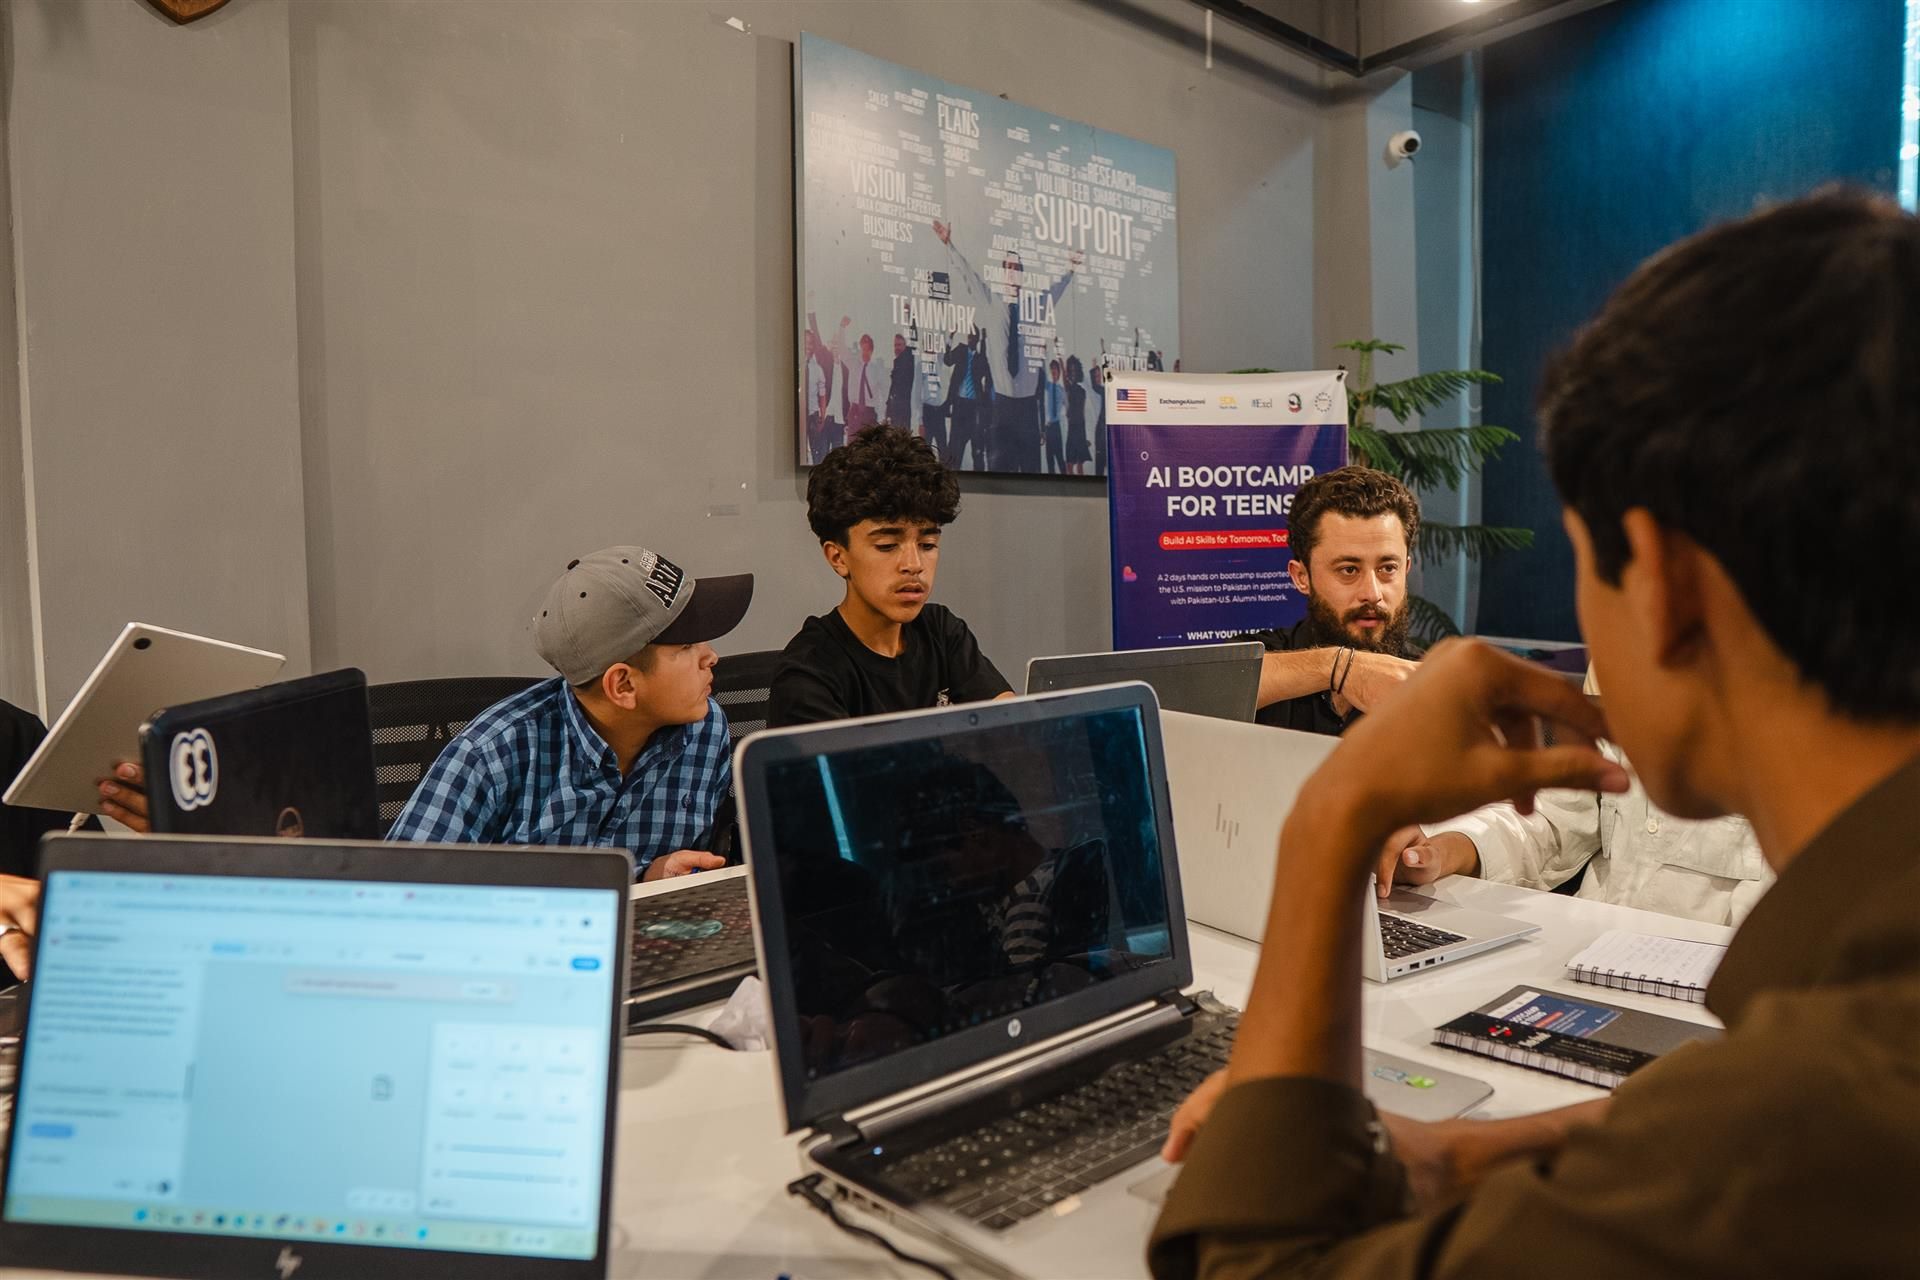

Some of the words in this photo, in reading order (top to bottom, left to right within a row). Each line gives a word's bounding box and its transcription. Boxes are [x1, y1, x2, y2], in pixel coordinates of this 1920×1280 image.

[937, 102, 979, 138] PLANS
[850, 159, 906, 204] VISION
[1035, 170, 1090, 202] VOLUNTEER
[1087, 162, 1136, 193] RESEARCH
[907, 197, 942, 218] EXPERTISE
[1001, 190, 1034, 215] SHARES
[864, 214, 913, 243] BUSINESS
[1034, 193, 1133, 260] SUPPORT
[992, 234, 1019, 251] ADVICE
[914, 267, 932, 282] SALES
[983, 264, 1051, 290] COMMUNICATION
[911, 280, 933, 296] PLANS
[889, 293, 976, 335] TEAMWORK
[1019, 289, 1057, 326] IDEA
[923, 331, 946, 353] IDEA
[1159, 398, 1206, 406] ExchangeAlumni
[1146, 466, 1171, 488] AI
[1178, 465, 1315, 488] BOOTCAMP
[1167, 495, 1216, 517] FOR
[1221, 493, 1296, 516] TEENS
[1163, 536, 1184, 545] Build
[1186, 536, 1195, 545] AI
[1196, 535, 1216, 545] Skills
[1217, 535, 1228, 544] for
[1229, 534, 1271, 545] Tomorrow,
[1157, 574, 1164, 582] A
[1164, 574, 1169, 582] 2
[1170, 574, 1186, 583] days
[1187, 573, 1208, 581] hands
[1219, 571, 1254, 581] bootcamp
[1159, 586, 1171, 594] the
[1172, 586, 1185, 594] U.S.
[1186, 585, 1213, 593] mission
[1222, 584, 1252, 592] Pakistan
[1253, 583, 1260, 591] in
[1170, 598, 1187, 606] with
[1232, 594, 1257, 603] Alumni
[1258, 594, 1288, 602] Network.
[1187, 631, 1213, 640] WHAT
